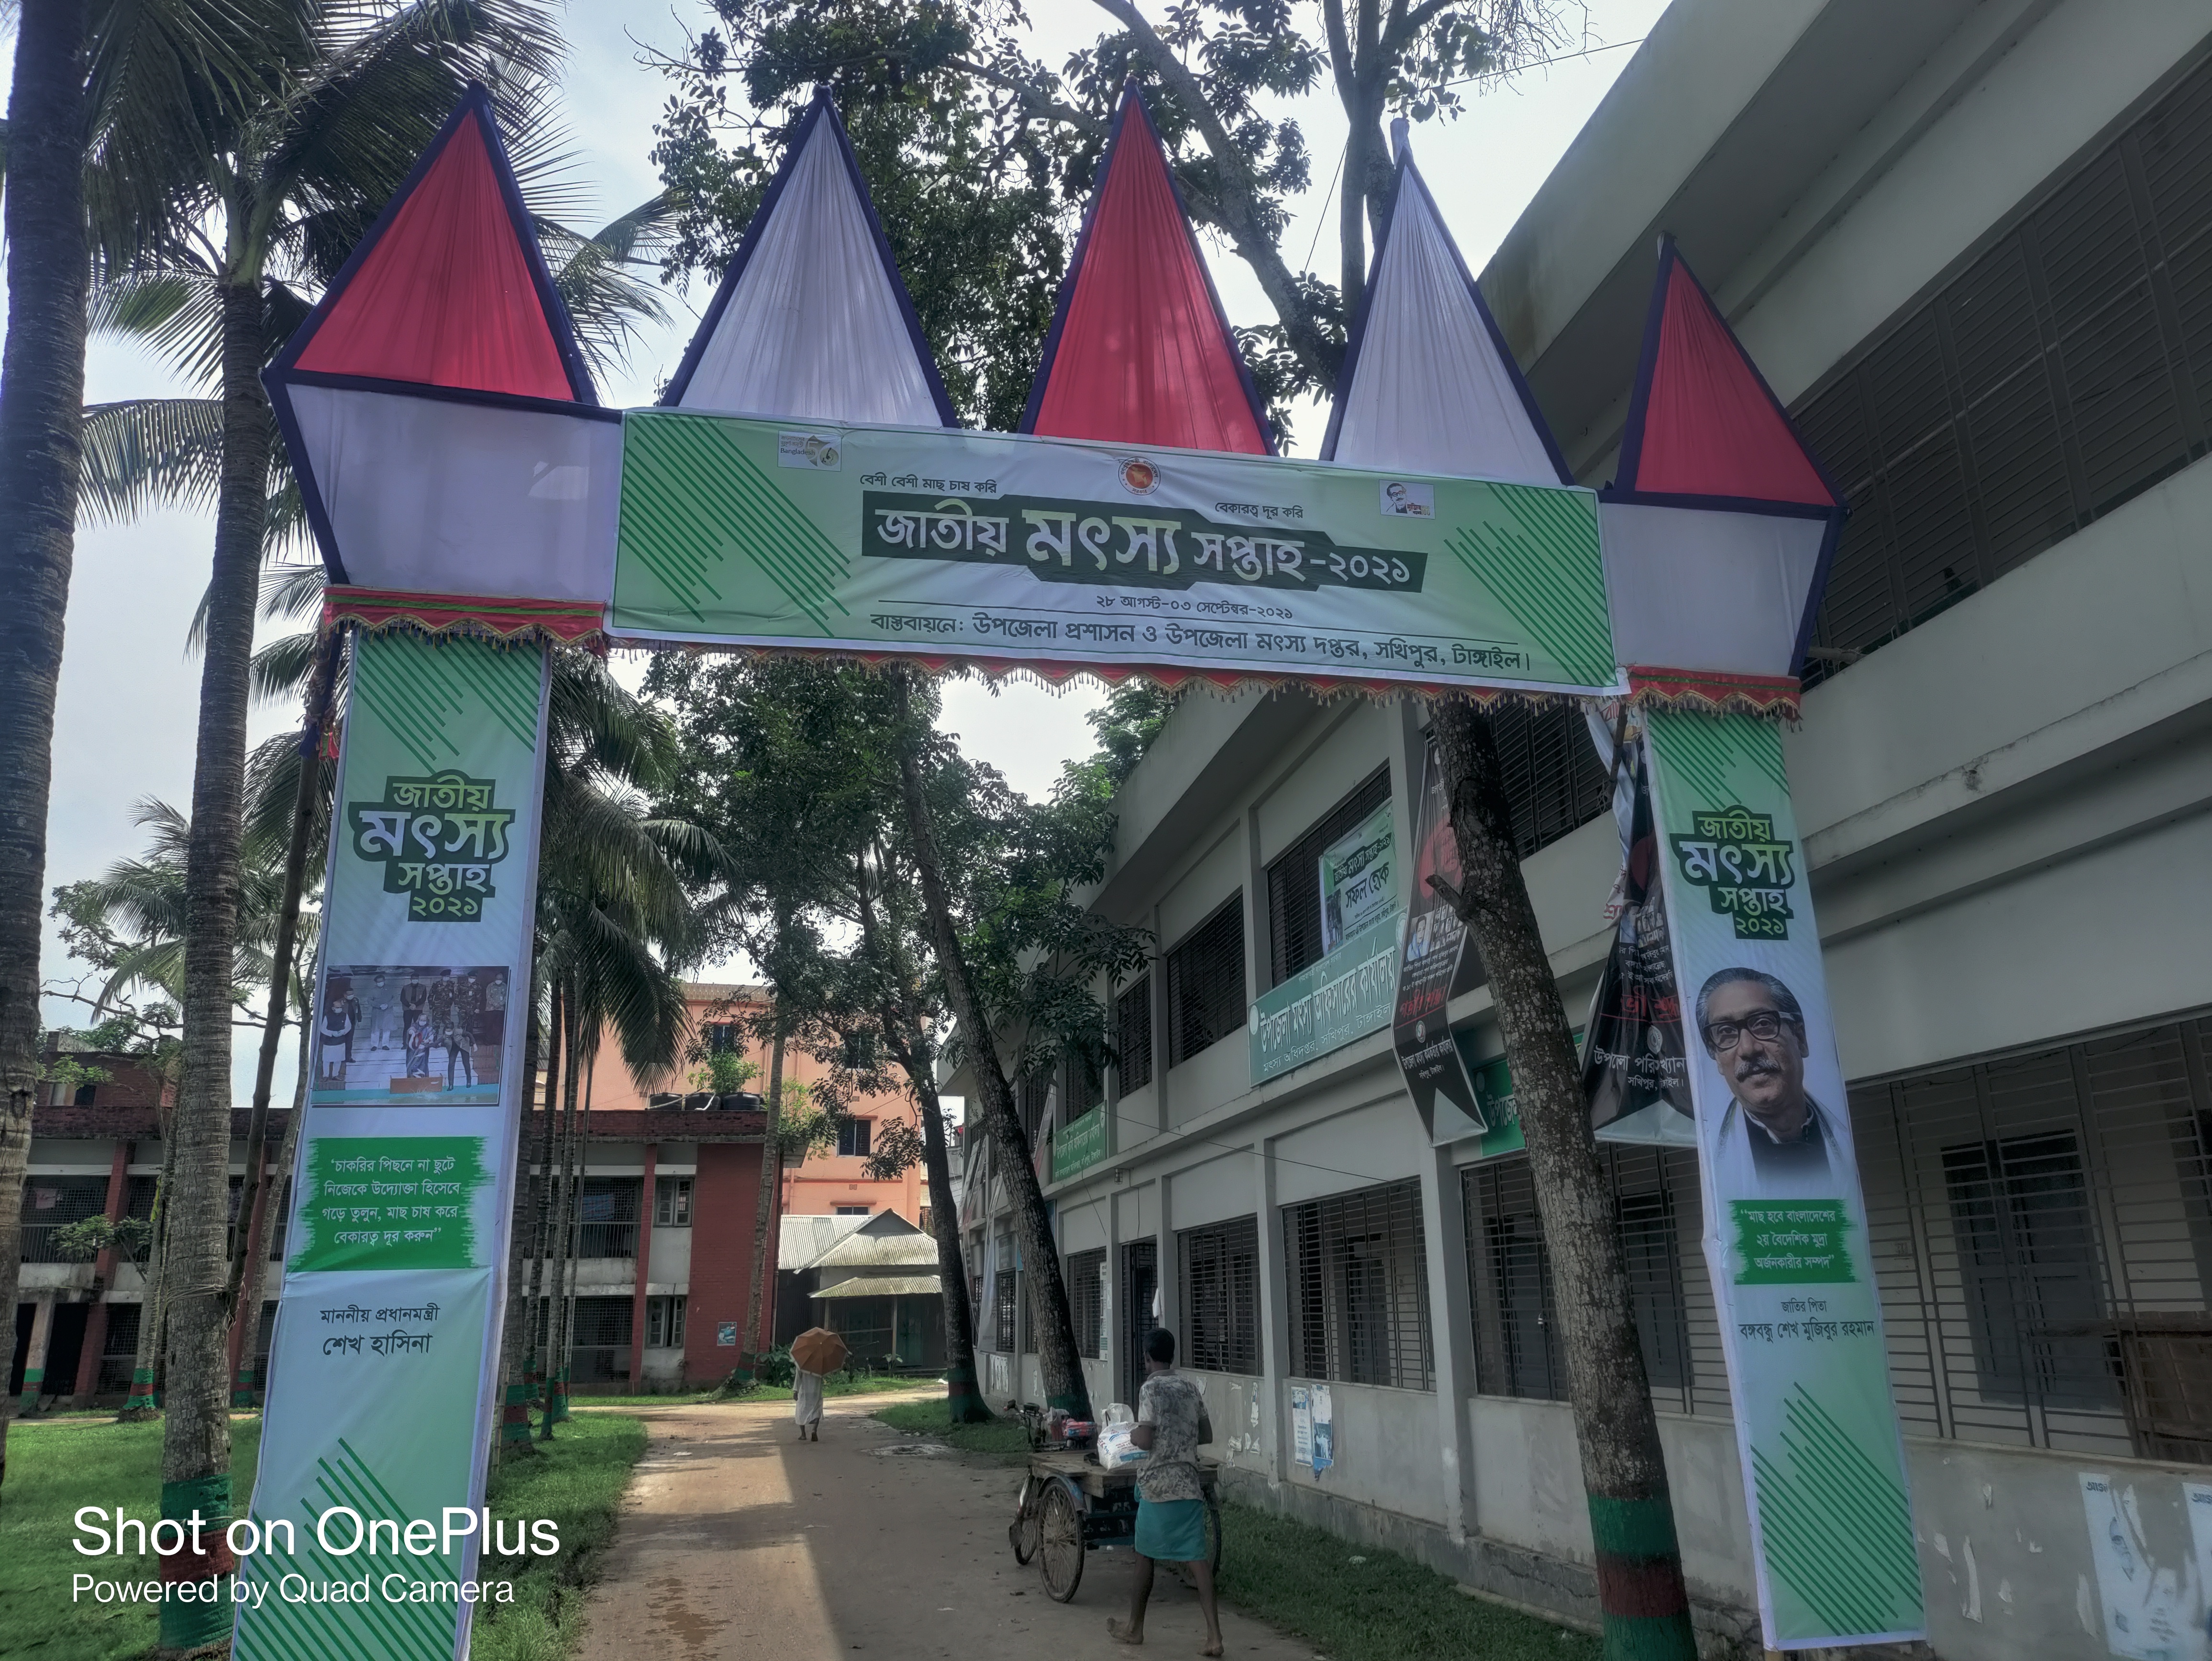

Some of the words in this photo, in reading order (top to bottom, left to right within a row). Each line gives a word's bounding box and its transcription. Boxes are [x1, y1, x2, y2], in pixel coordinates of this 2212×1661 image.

[860, 472, 887, 486] বেশী
[891, 474, 918, 488] বেশী
[923, 478, 945, 491] মাছ
[949, 480, 970, 491] চাষ
[974, 479, 997, 493] করি
[1215, 502, 1259, 518] বেকারত্ব
[1262, 506, 1278, 520] দূর
[1282, 505, 1304, 518] করি
[874, 498, 1009, 557] জাতীয়
[1022, 509, 1182, 574] মৎস্য
[1096, 595, 1115, 608] ২৮
[972, 612, 1058, 639] উপজেলা
[1065, 621, 1136, 642] প্রশাসন
[1142, 626, 1157, 642] ও
[1164, 623, 1248, 649] উপজেলা
[1256, 632, 1306, 653] মৎস্য
[1313, 636, 1368, 660] দপ্তর,
[1373, 637, 1446, 670] সখিপুর,
[393, 775, 491, 812] জাতীয়
[1431, 778, 1444, 795] জাতী
[359, 810, 510, 860] মৎস্য
[1697, 809, 1771, 843] জাতীয়
[1348, 850, 1364, 874] মৎস্য
[1679, 841, 1792, 885] মৎস্য
[398, 863, 490, 895] সপ্তাহ
[1345, 877, 1367, 908] সফল
[1369, 862, 1389, 894] হোক
[412, 897, 479, 917] ২০২১
[1717, 887, 1787, 916] সপ্তাহ
[1736, 917, 1784, 936] ২০২১
[1260, 1001, 1291, 1053] উপজেলা
[1291, 994, 1312, 1041] মৎস্য
[1313, 970, 1358, 1029] অফিসারের
[1358, 936, 1395, 1007] কার্যালয়
[1263, 1056, 1282, 1073] মৎস্য
[1283, 1040, 1319, 1063] অধিদপ্তর,
[1356, 1002, 1392, 1030] টাঙ্গাইল
[378, 1156, 415, 1173] পিছনে
[417, 1158, 431, 1173] না
[433, 1155, 456, 1175] ছুটে
[323, 1180, 369, 1196] নিজেকে
[371, 1179, 419, 1196] উদ্যোক্তা
[421, 1178, 462, 1196] হিসেবে
[322, 1206, 347, 1223] গড়ে
[350, 1207, 382, 1224] তুলুন,
[386, 1205, 409, 1220] মাছ
[411, 1205, 432, 1219] চাষ
[434, 1206, 459, 1218] করে
[1766, 1211, 1784, 1225] হবে
[1785, 1209, 1836, 1224] বাংলাদেশের
[334, 1231, 381, 1247] বেকারত্ব
[384, 1230, 401, 1247] দূর
[1770, 1229, 1809, 1247] বৈদেশিক
[1811, 1232, 1828, 1249] মুদ্রা
[1753, 1253, 1802, 1269] অর্জনকারীর
[320, 1304, 372, 1323] মাননীয়
[376, 1302, 441, 1323] প্রধানমন্ত্রী
[1781, 1297, 1806, 1313] জাতির
[1808, 1297, 1827, 1313] পিতা
[1738, 1323, 1774, 1344] বঙ্গবন্ধু
[1778, 1320, 1799, 1339] শেখ
[1801, 1317, 1837, 1342] মুজিবুর
[1840, 1320, 1874, 1339] রহমান
[323, 1334, 365, 1356] শেখ
[369, 1329, 433, 1357] হাসিনা
